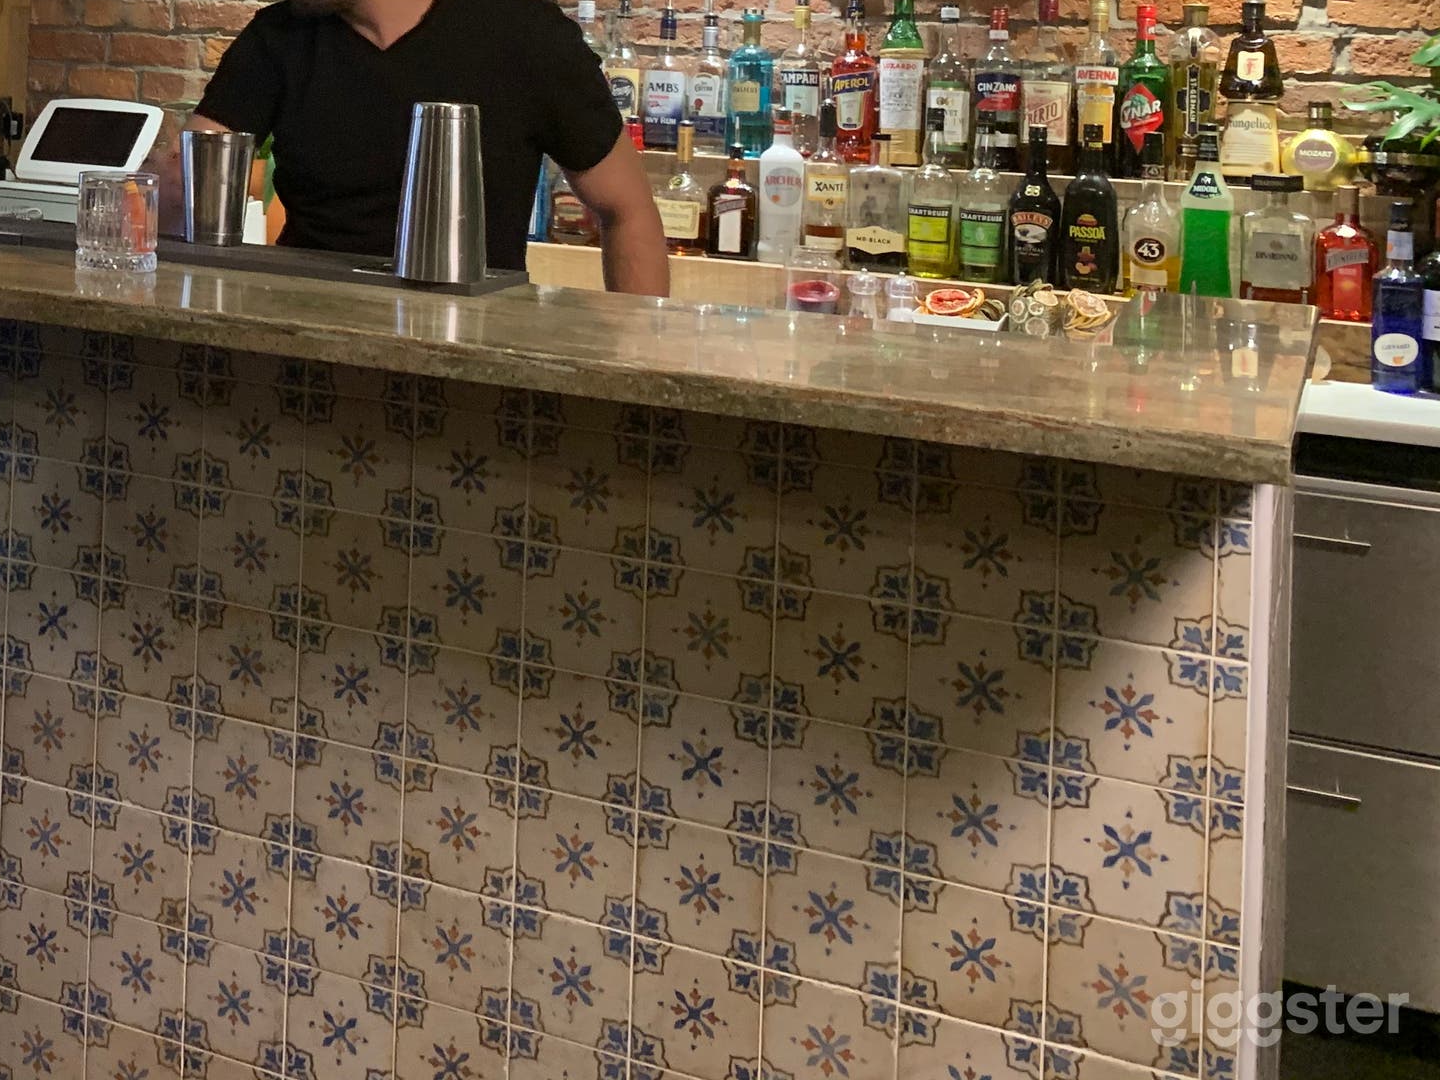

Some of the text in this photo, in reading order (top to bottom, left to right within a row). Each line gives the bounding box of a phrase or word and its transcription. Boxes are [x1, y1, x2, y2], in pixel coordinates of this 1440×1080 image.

[1077, 70, 1117, 81] AVERNA
[834, 77, 870, 93] APEROL
[977, 81, 1017, 92] CINZANO
[1121, 100, 1161, 129] CYNAR
[1299, 149, 1333, 158] MOZART
[1193, 185, 1218, 193] MIDORI
[908, 207, 949, 217] CHARTREUSE
[961, 212, 1003, 222] CHARTREUSE
[1137, 242, 1160, 258] 43
